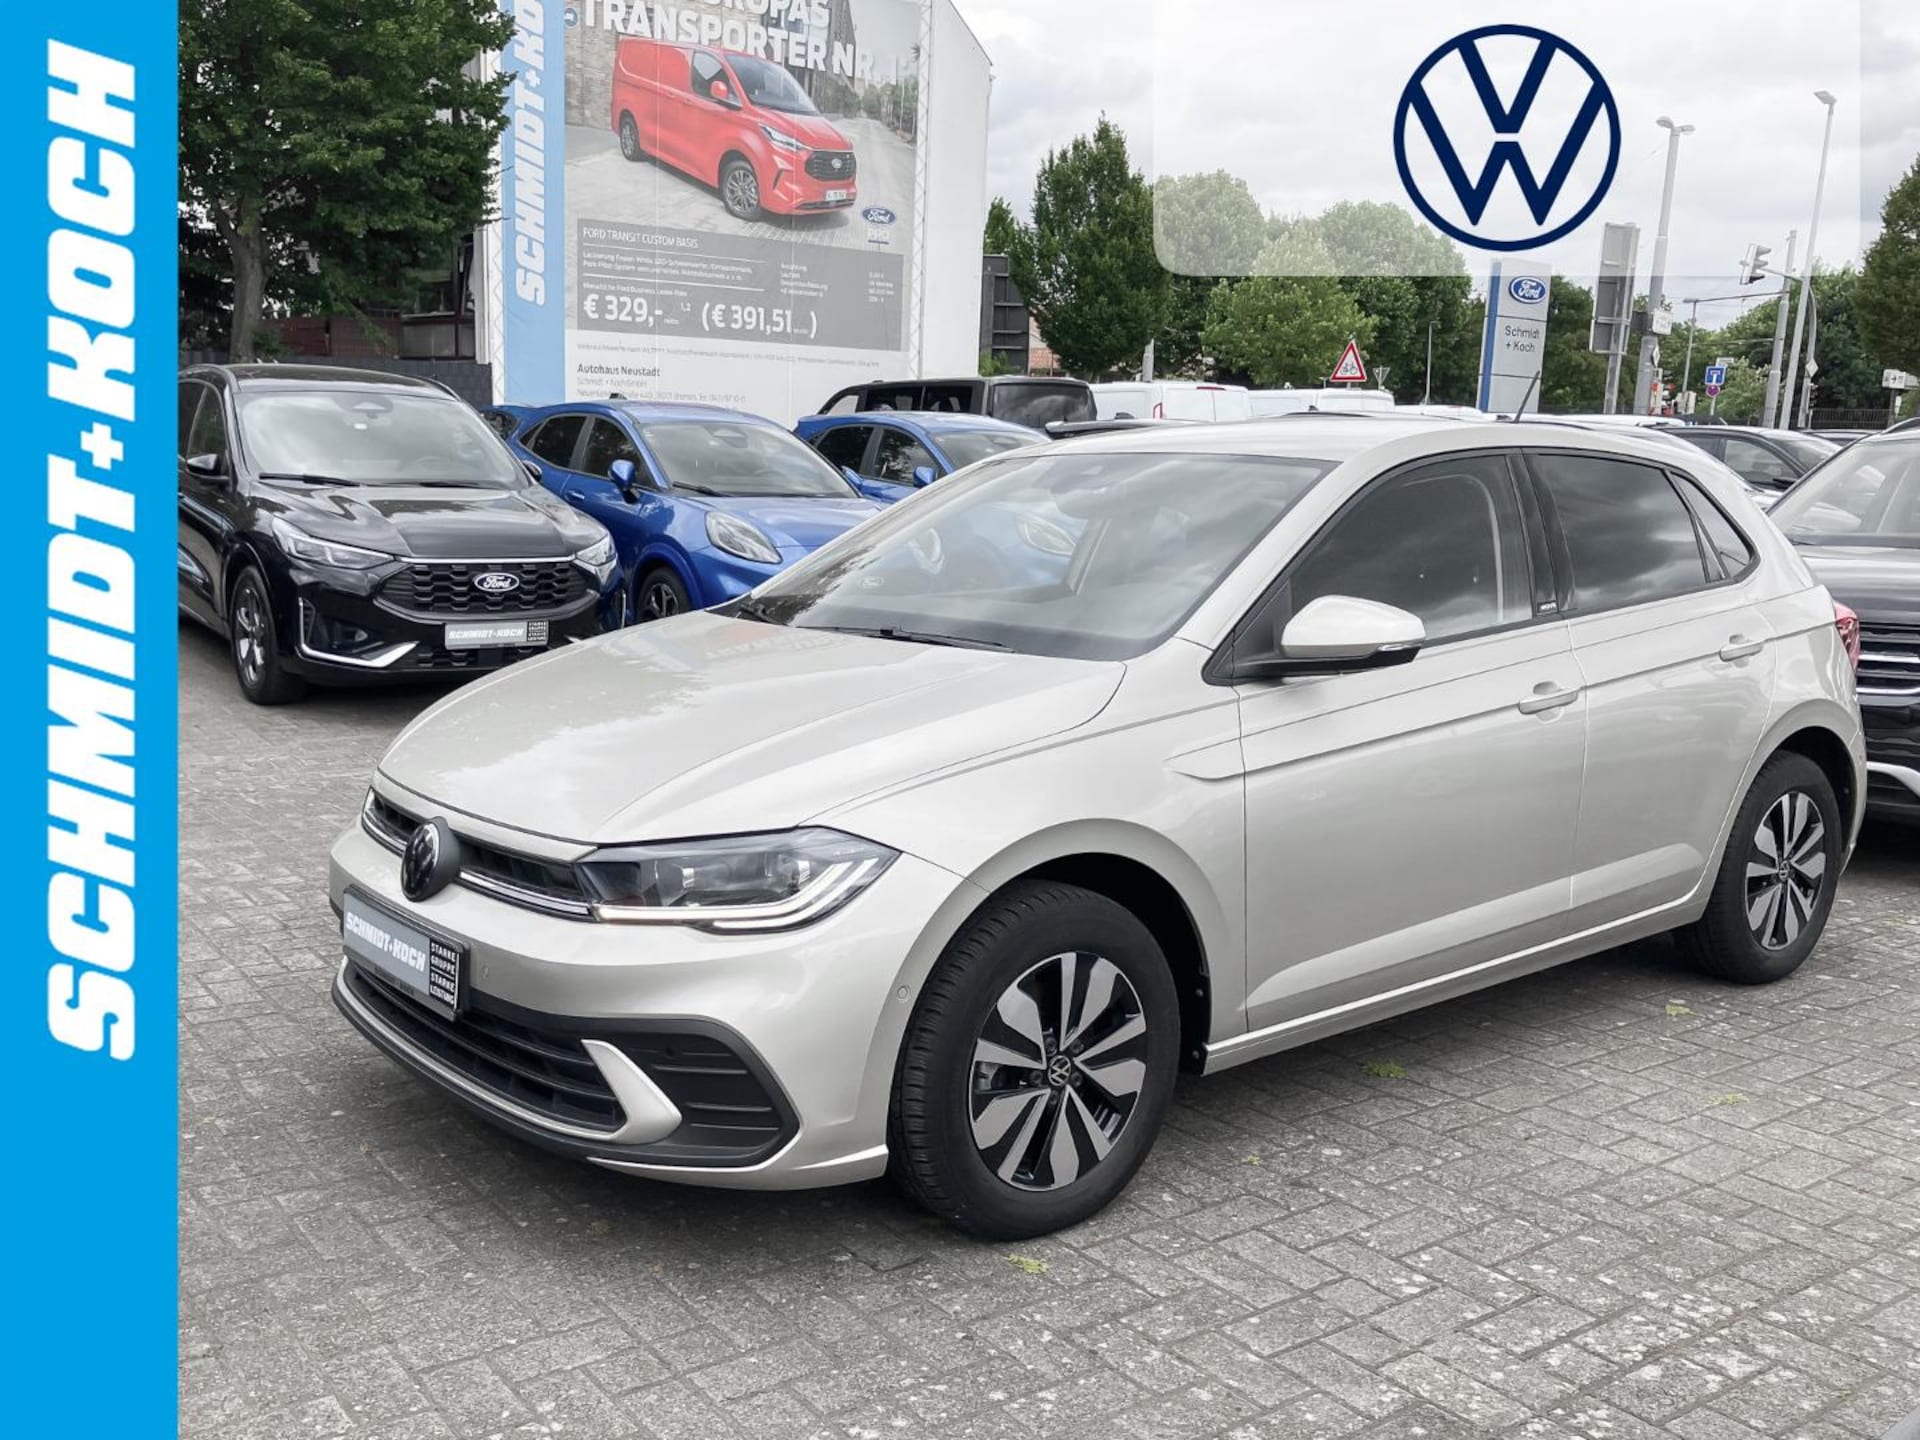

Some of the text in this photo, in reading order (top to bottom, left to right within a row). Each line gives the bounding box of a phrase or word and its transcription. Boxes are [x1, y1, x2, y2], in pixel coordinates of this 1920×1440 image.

[583, 0, 827, 72] TRANSPORTER
[583, 227, 699, 249] FORD TRANSIT CUSTOM BASIS
[1516, 279, 1543, 300] Ford
[583, 294, 600, 320] €
[604, 294, 664, 327] 329,-
[730, 304, 793, 335] 391,51
[1504, 325, 1540, 340] Schmidt
[1513, 342, 1536, 353] Koch
[577, 363, 661, 378] Autohaus Neustadt
[482, 575, 513, 589] Ford
[430, 942, 456, 962] STARKE
[430, 972, 455, 993] STARKE
